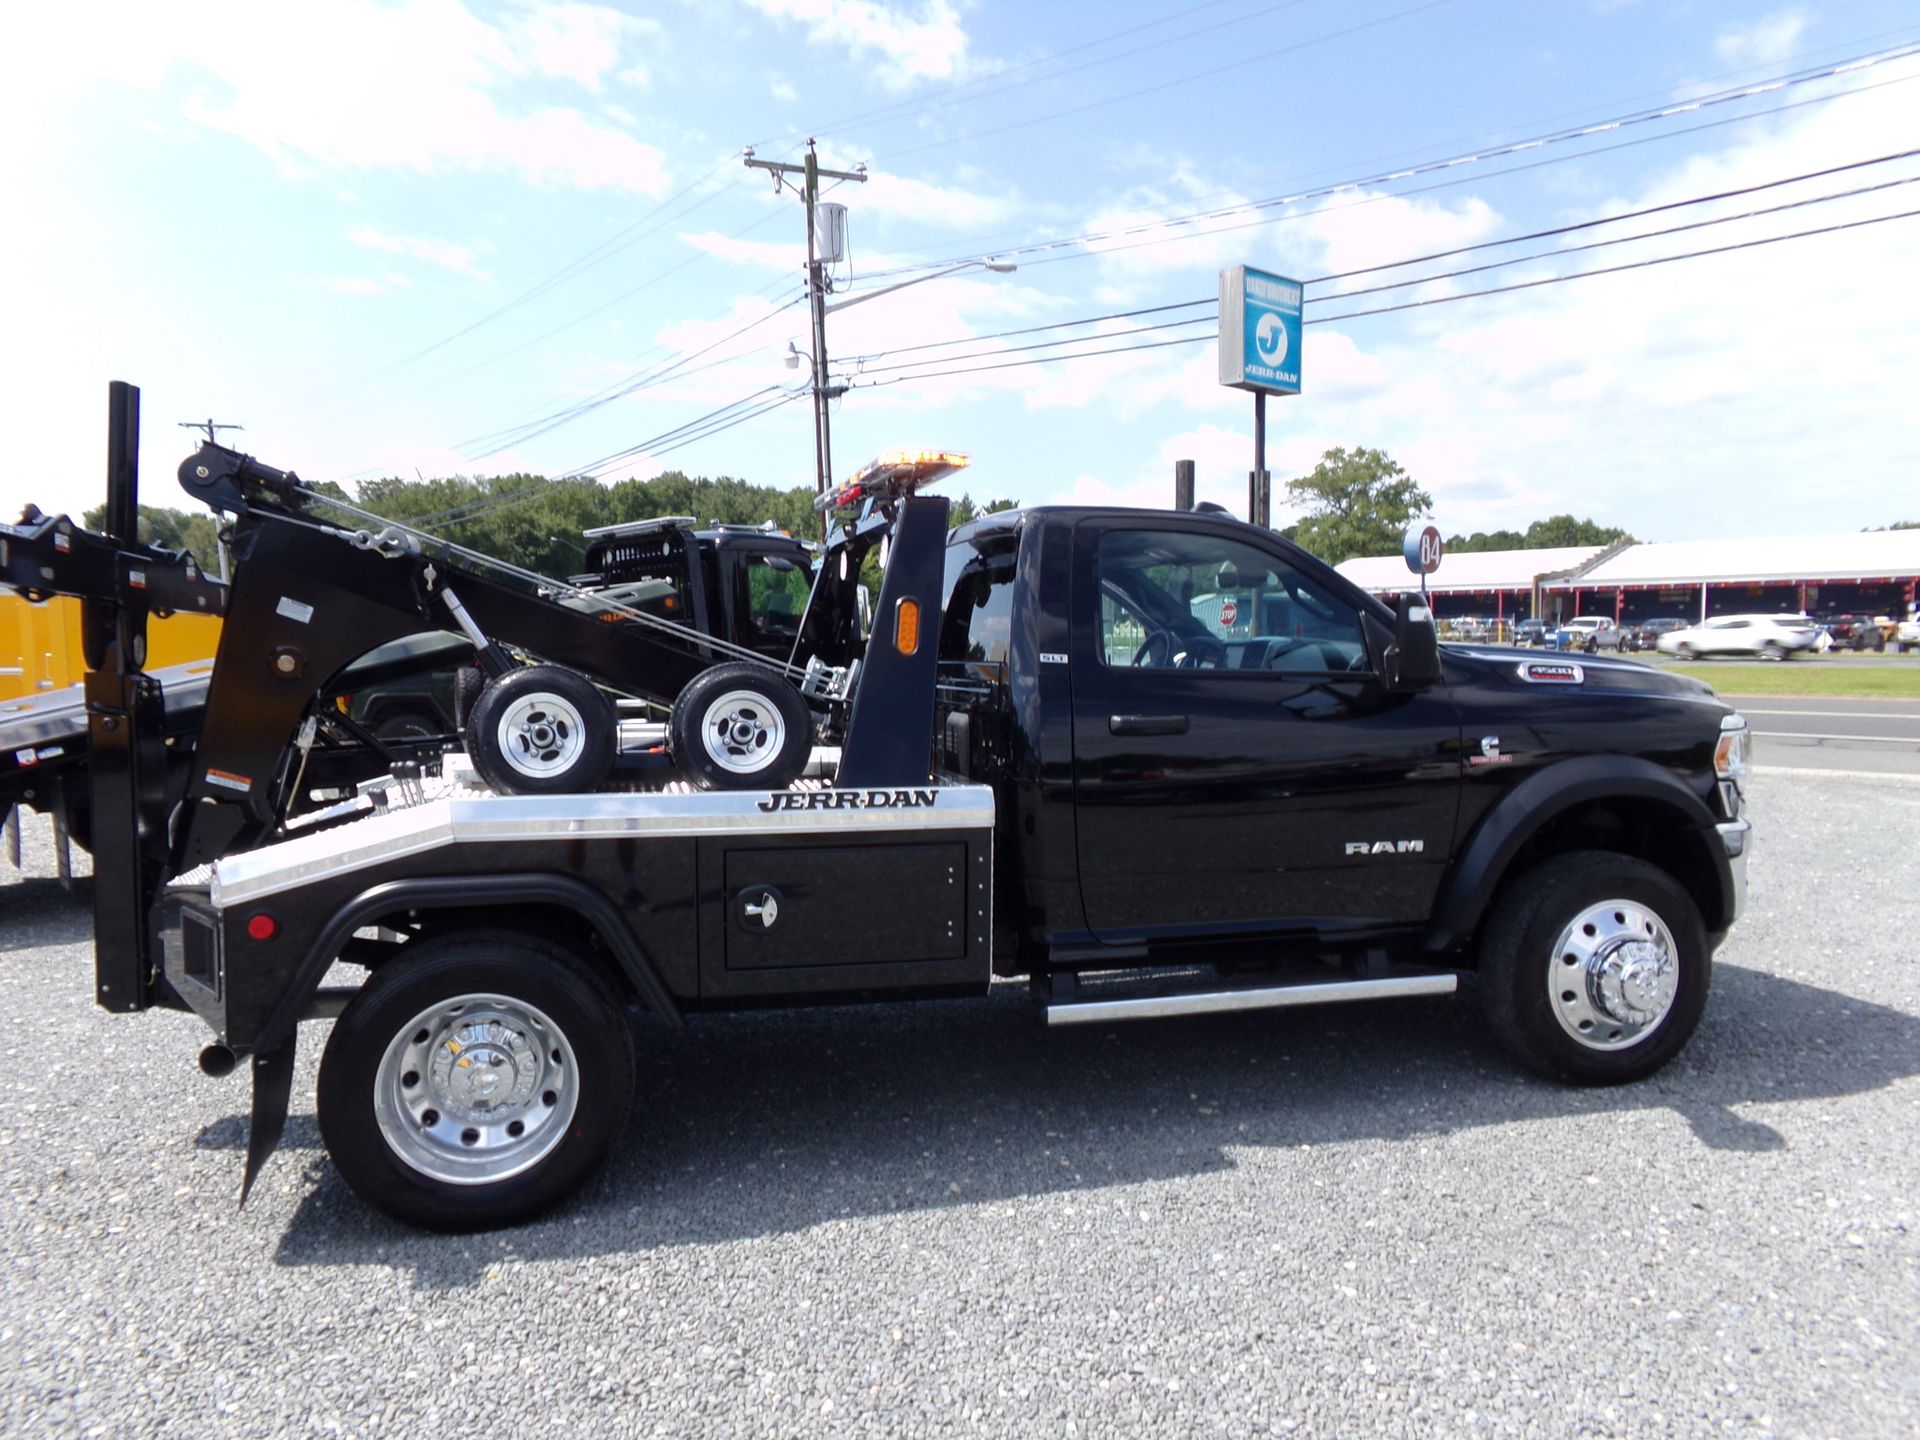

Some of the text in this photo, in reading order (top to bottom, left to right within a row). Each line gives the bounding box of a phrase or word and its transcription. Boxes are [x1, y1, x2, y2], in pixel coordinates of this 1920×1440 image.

[1421, 534, 1441, 566] 84
[757, 789, 940, 812] JERR-DAN
[1345, 840, 1424, 855] RAM
